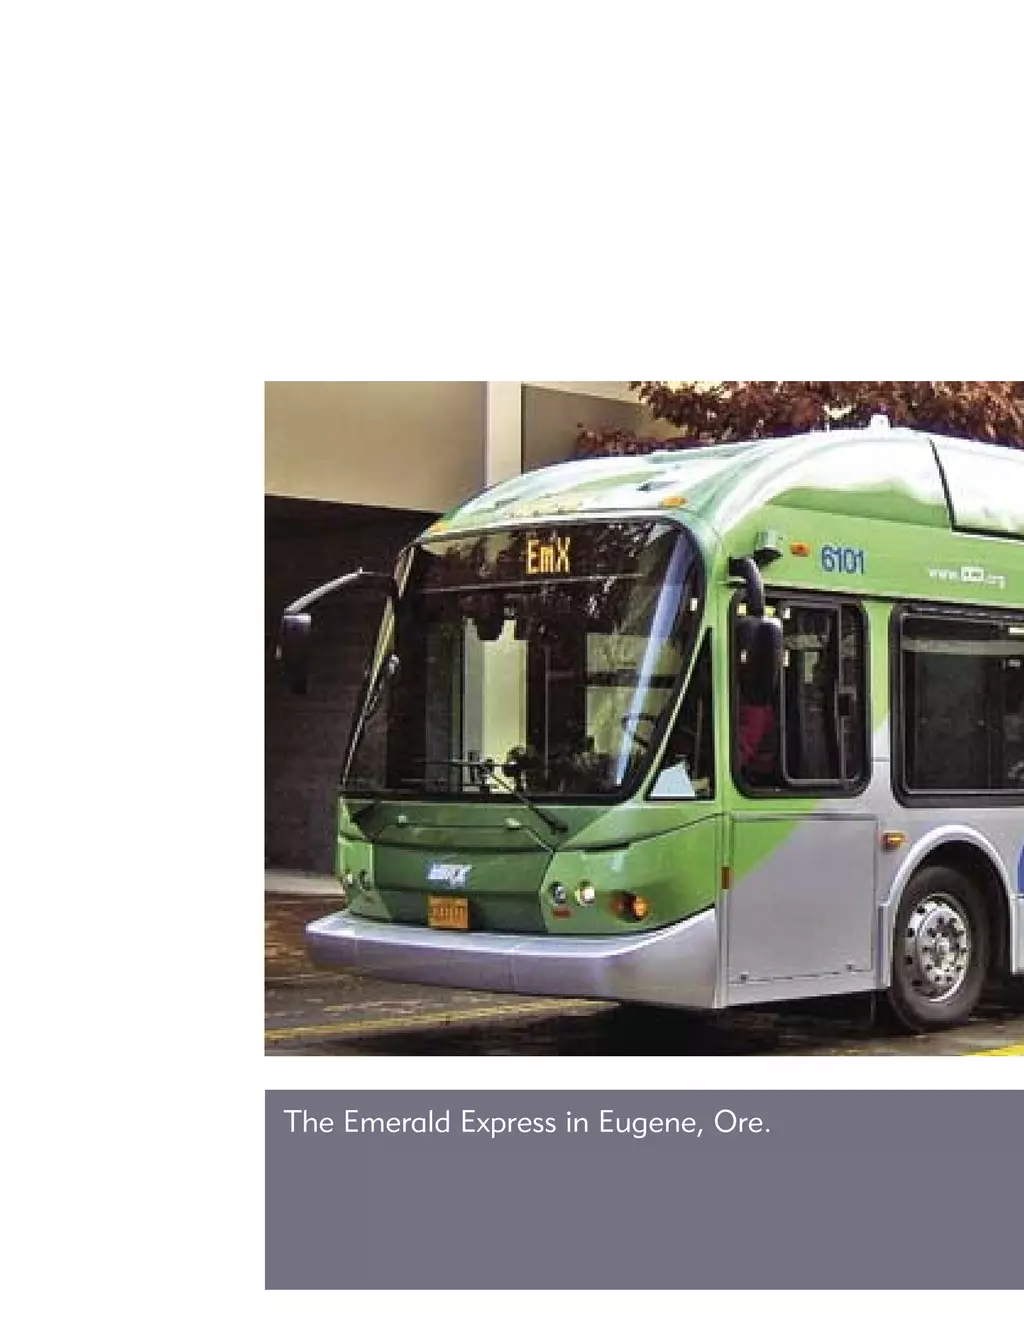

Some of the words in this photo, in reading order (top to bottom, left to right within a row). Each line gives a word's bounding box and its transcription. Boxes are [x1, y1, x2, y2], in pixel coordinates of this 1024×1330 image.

[527, 537, 570, 574] EmX
[821, 545, 865, 574] 6101
[282, 1109, 334, 1134] The
[344, 1109, 450, 1134] Emerald
[461, 1109, 557, 1139] Express
[566, 1110, 589, 1133] in
[600, 1109, 703, 1139] Eugene,
[714, 1108, 771, 1134] Ore.
